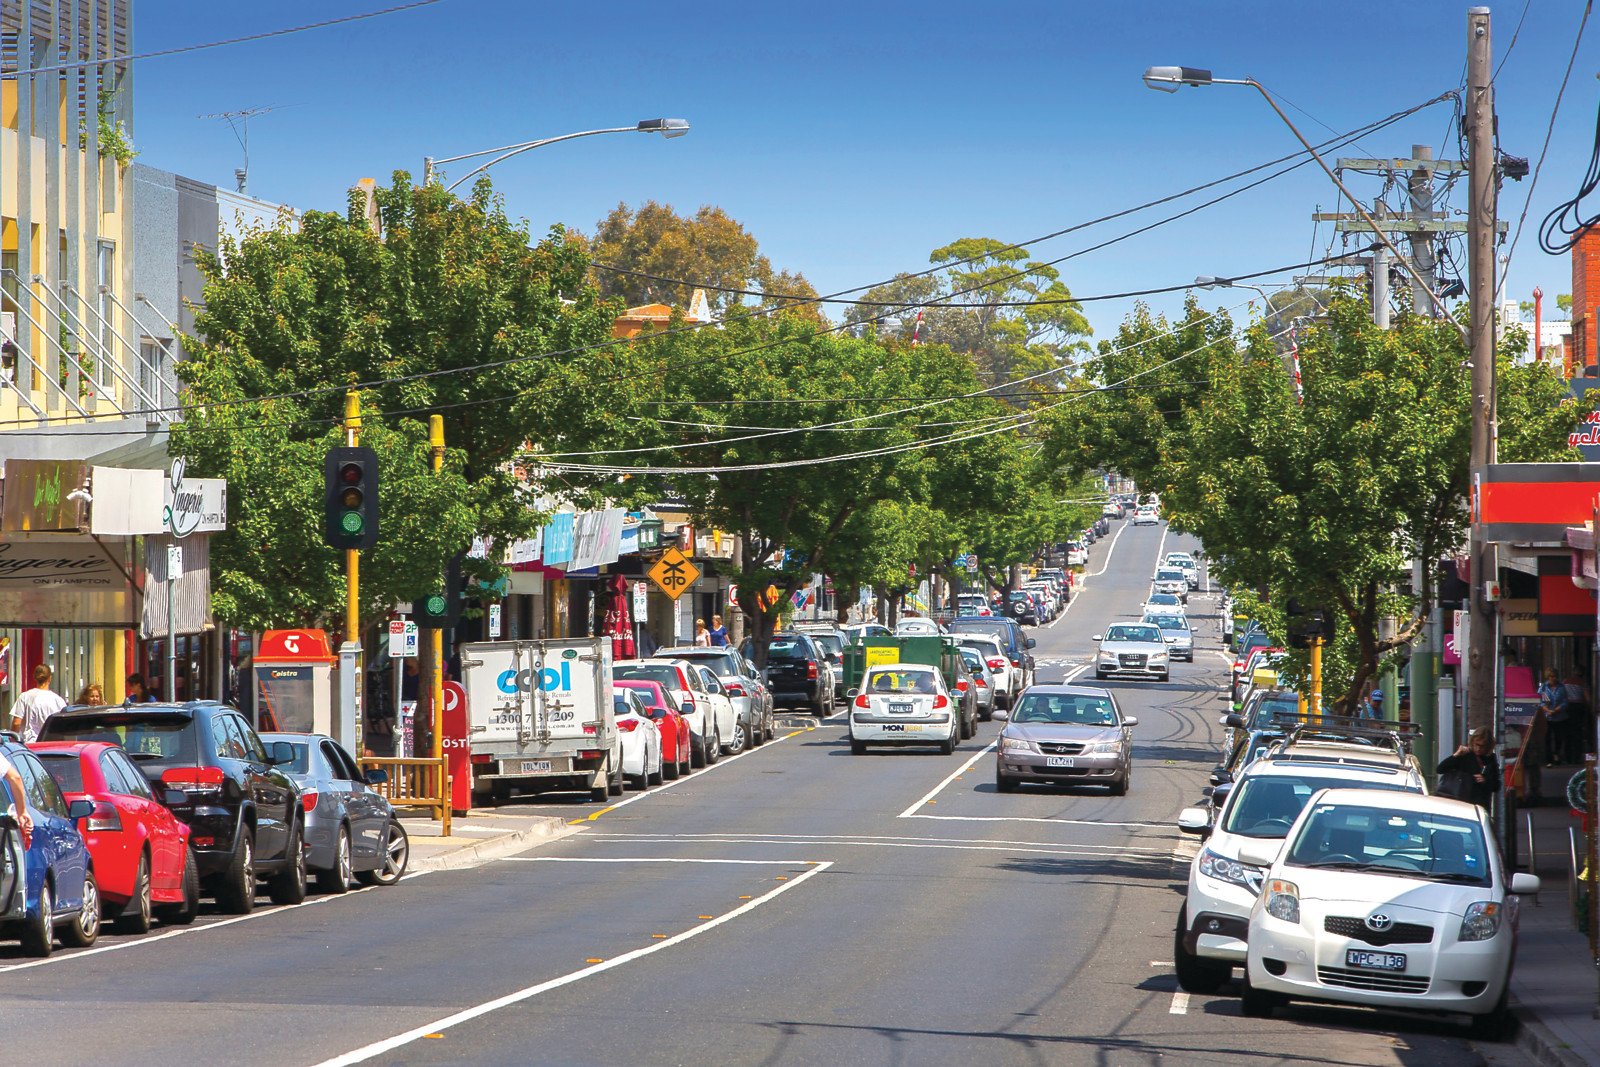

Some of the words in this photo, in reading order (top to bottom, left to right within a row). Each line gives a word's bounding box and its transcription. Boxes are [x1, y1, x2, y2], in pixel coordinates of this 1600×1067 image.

[405, 624, 417, 634] 2P
[497, 661, 571, 694] cool
[495, 714, 521, 724] 1300
[554, 711, 574, 722] 209
[442, 738, 467, 748] OST
